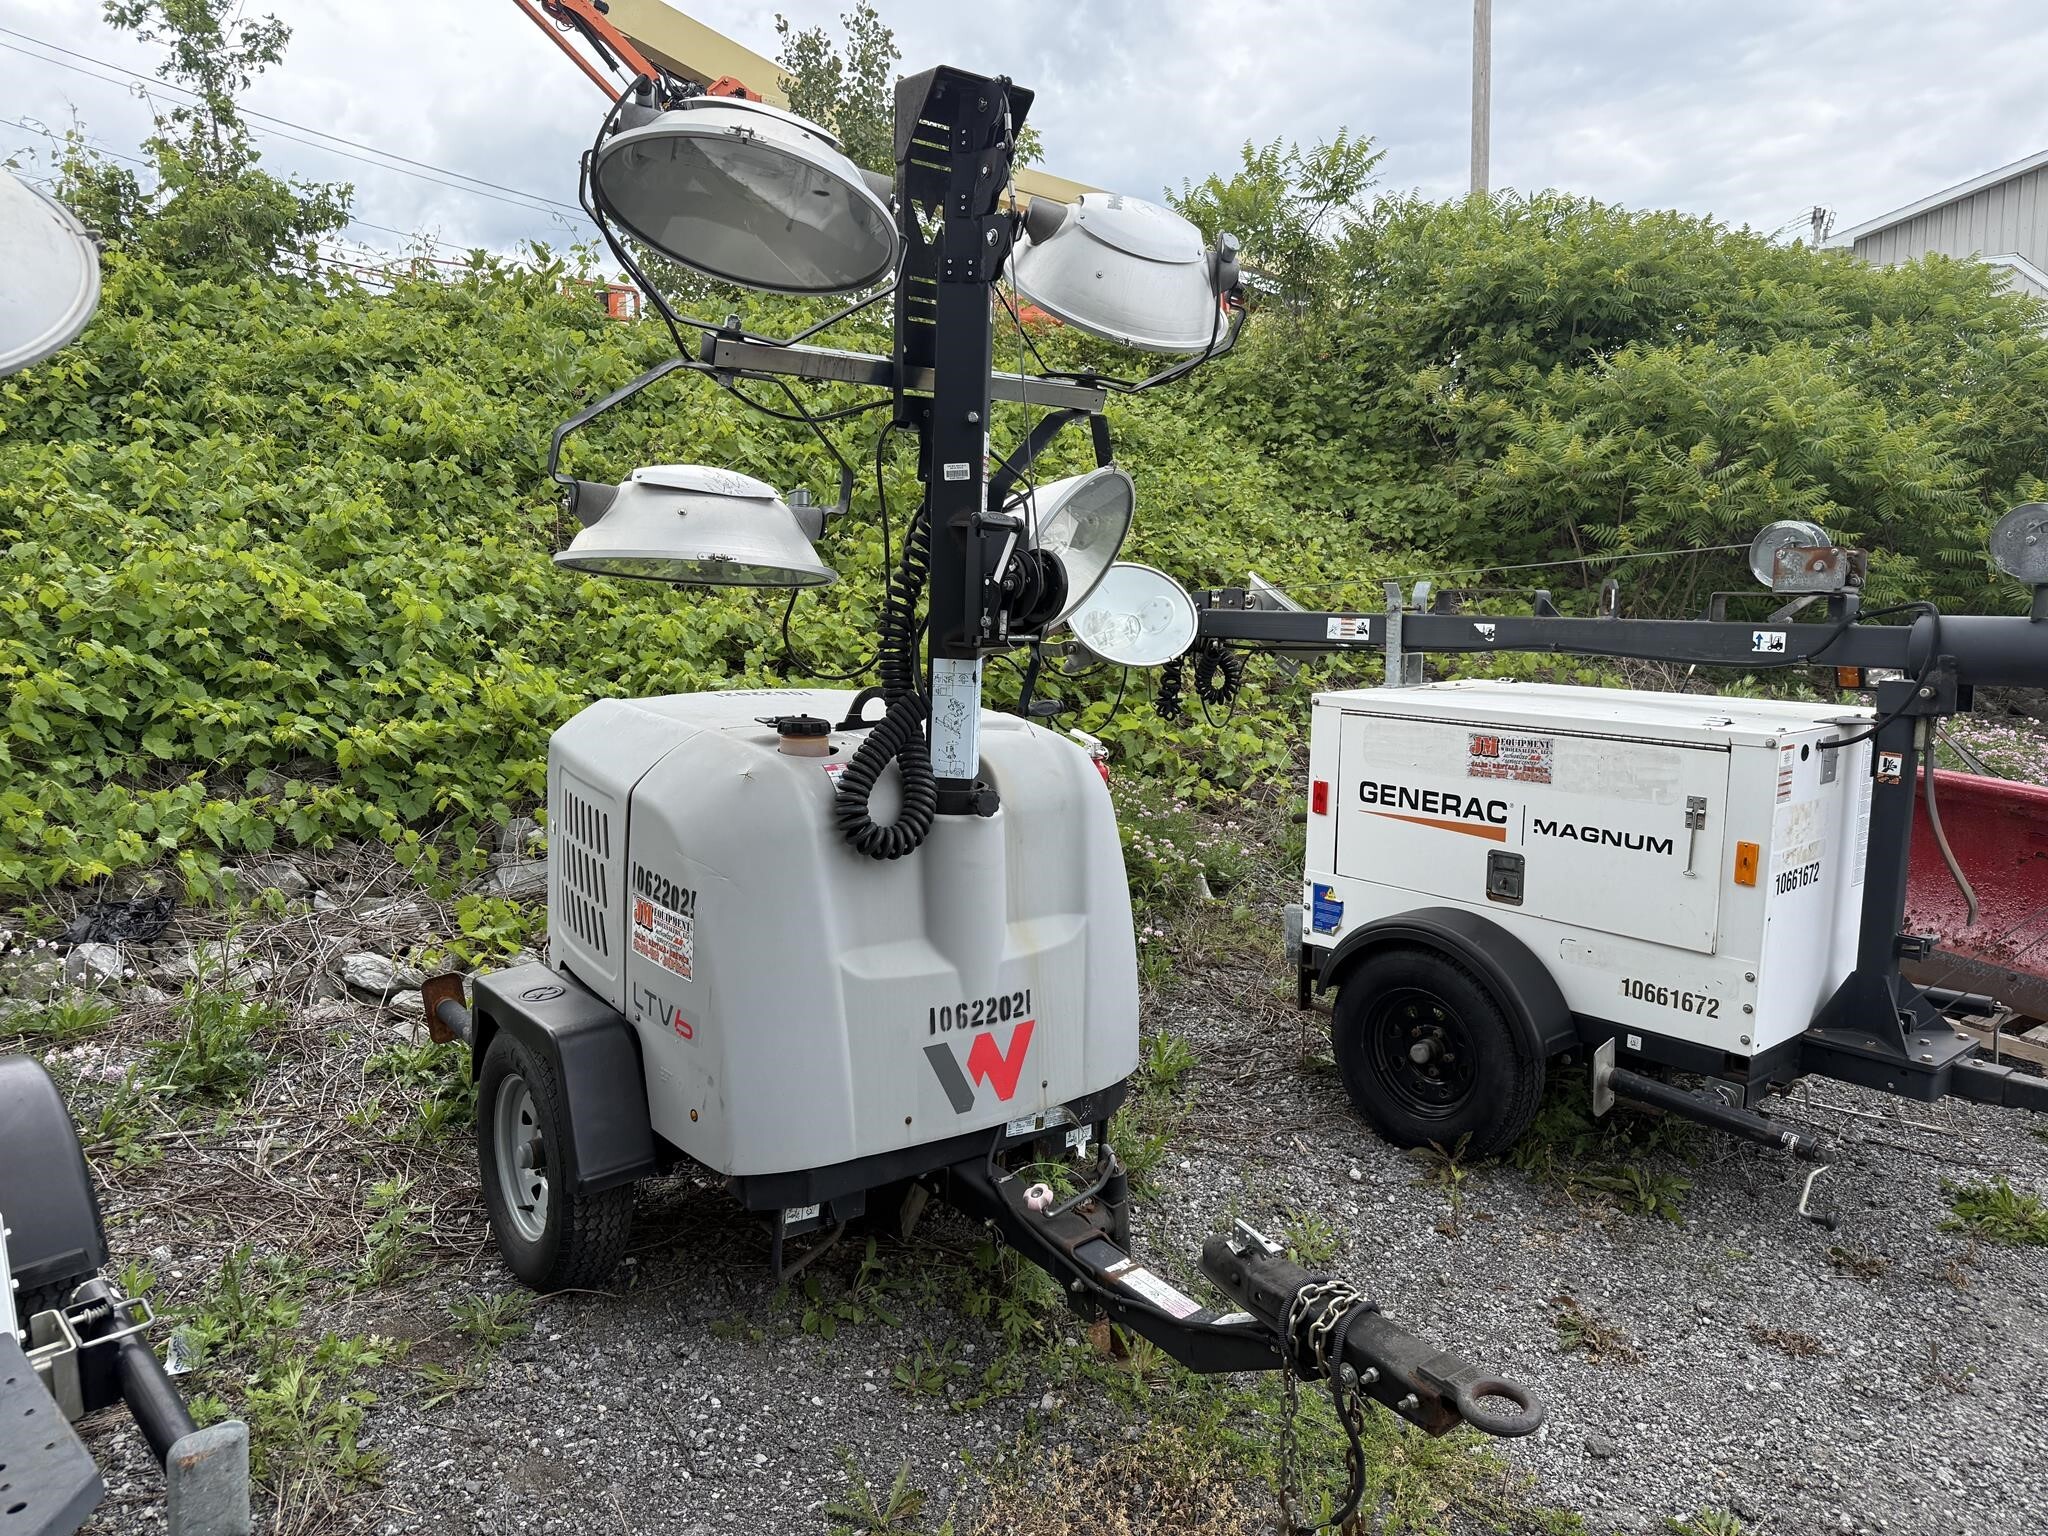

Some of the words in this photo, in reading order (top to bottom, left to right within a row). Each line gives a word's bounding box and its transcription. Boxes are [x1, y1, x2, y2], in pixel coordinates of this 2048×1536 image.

[1470, 736, 1498, 757] JM
[1501, 738, 1549, 749] EQUIPMENT
[1359, 781, 1508, 824] GENERAC
[1533, 819, 1674, 856] MAGNUM
[1776, 861, 1820, 896] 10661672
[634, 898, 654, 931] JM
[929, 989, 1031, 1035] 10622021
[1621, 978, 1720, 1019] 10661672
